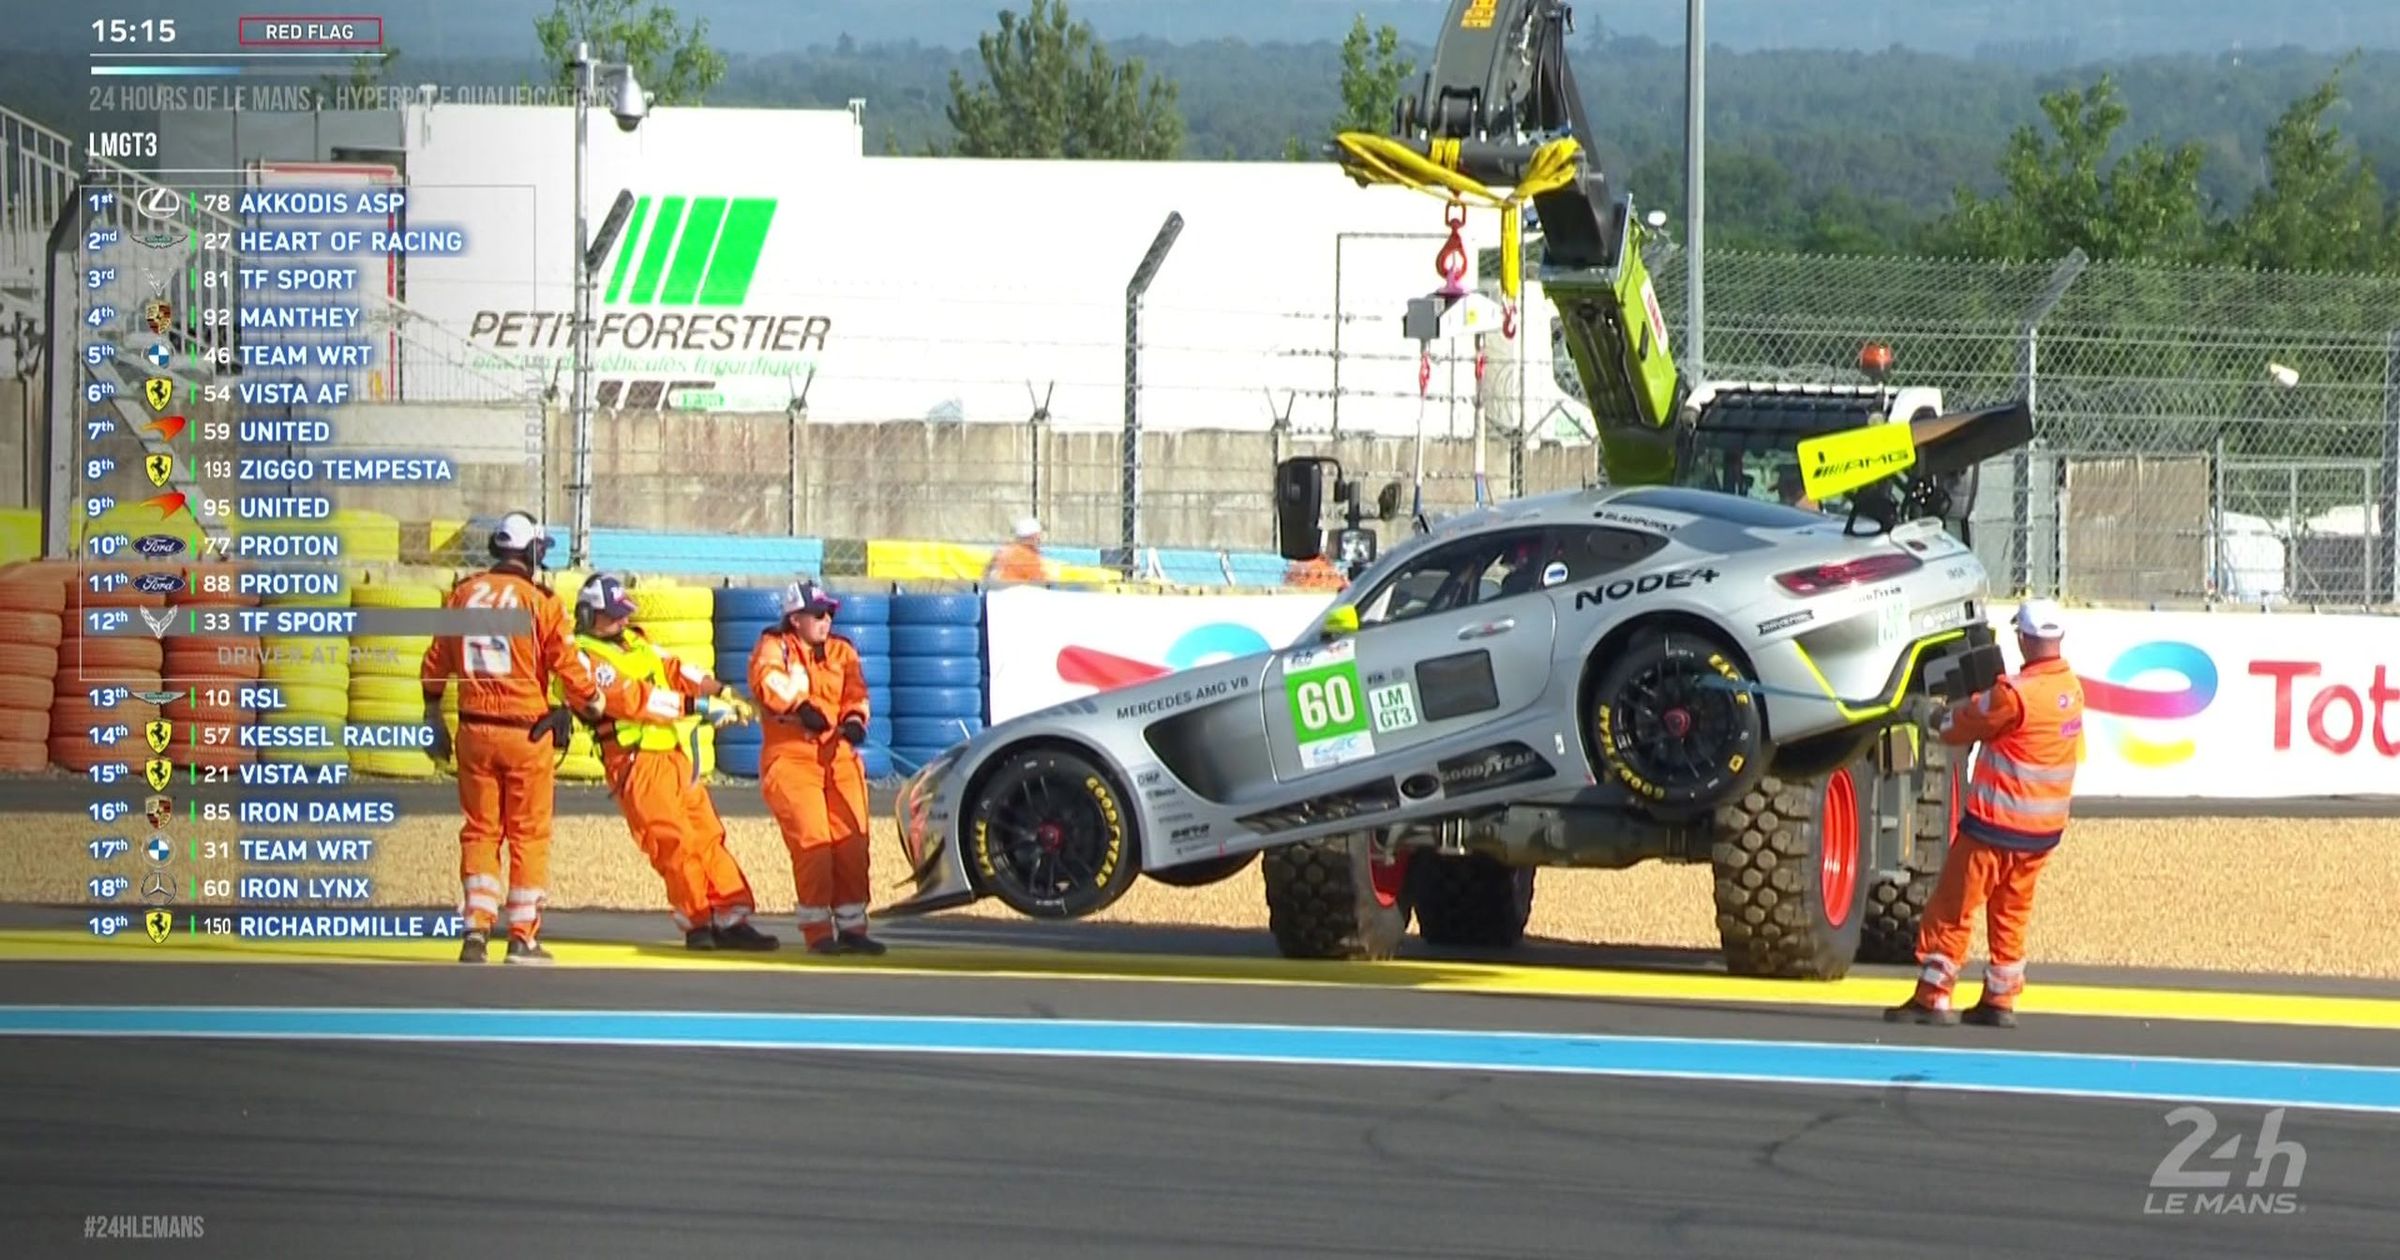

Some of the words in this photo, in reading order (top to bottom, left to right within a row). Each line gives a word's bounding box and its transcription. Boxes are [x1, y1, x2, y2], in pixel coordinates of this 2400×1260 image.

[596, 312, 831, 351] FORESTIER
[1116, 691, 1193, 720] MERCEDES
[1230, 675, 1250, 691] V8
[1378, 687, 1404, 708] LM
[1709, 653, 1749, 706] EAGE
[1297, 674, 1355, 730] 60
[1380, 706, 1412, 728] GT3
